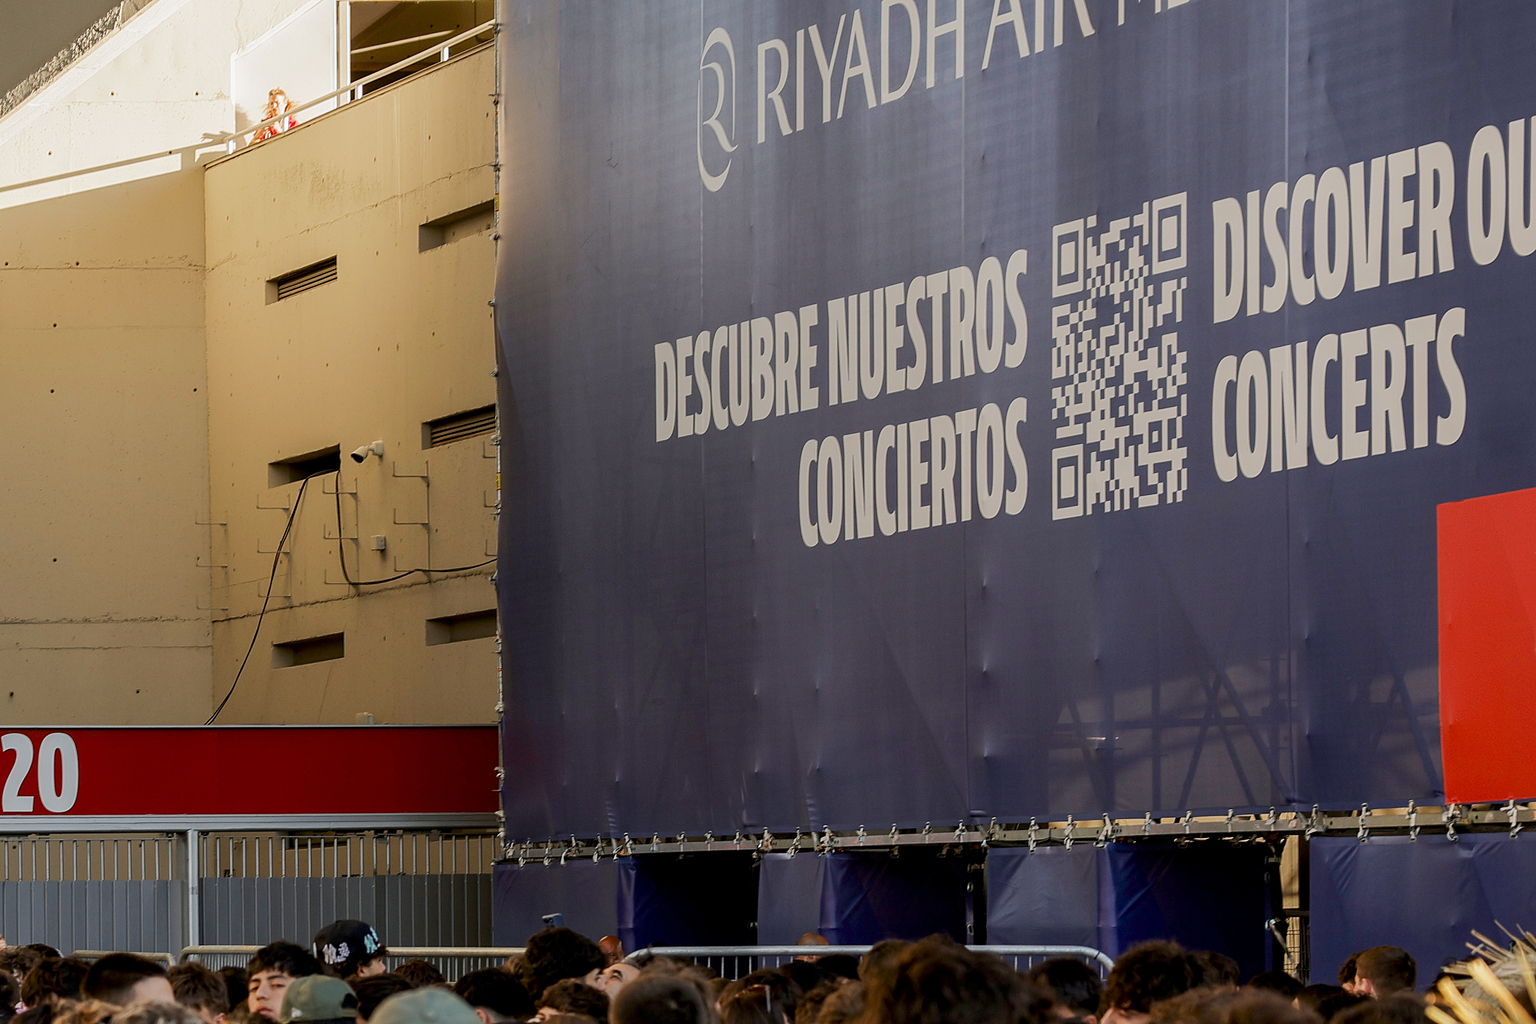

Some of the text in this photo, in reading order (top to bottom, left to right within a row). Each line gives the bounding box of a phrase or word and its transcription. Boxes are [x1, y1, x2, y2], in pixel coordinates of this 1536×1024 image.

[757, 0, 964, 144] RIYADH
[1212, 141, 1455, 324] DISCOVER
[654, 248, 1028, 443] DESCUBRE NUESTROS
[1211, 306, 1467, 482] CONCERTS
[798, 397, 1029, 548] CONCIERTOS
[0, 732, 80, 813] 20
